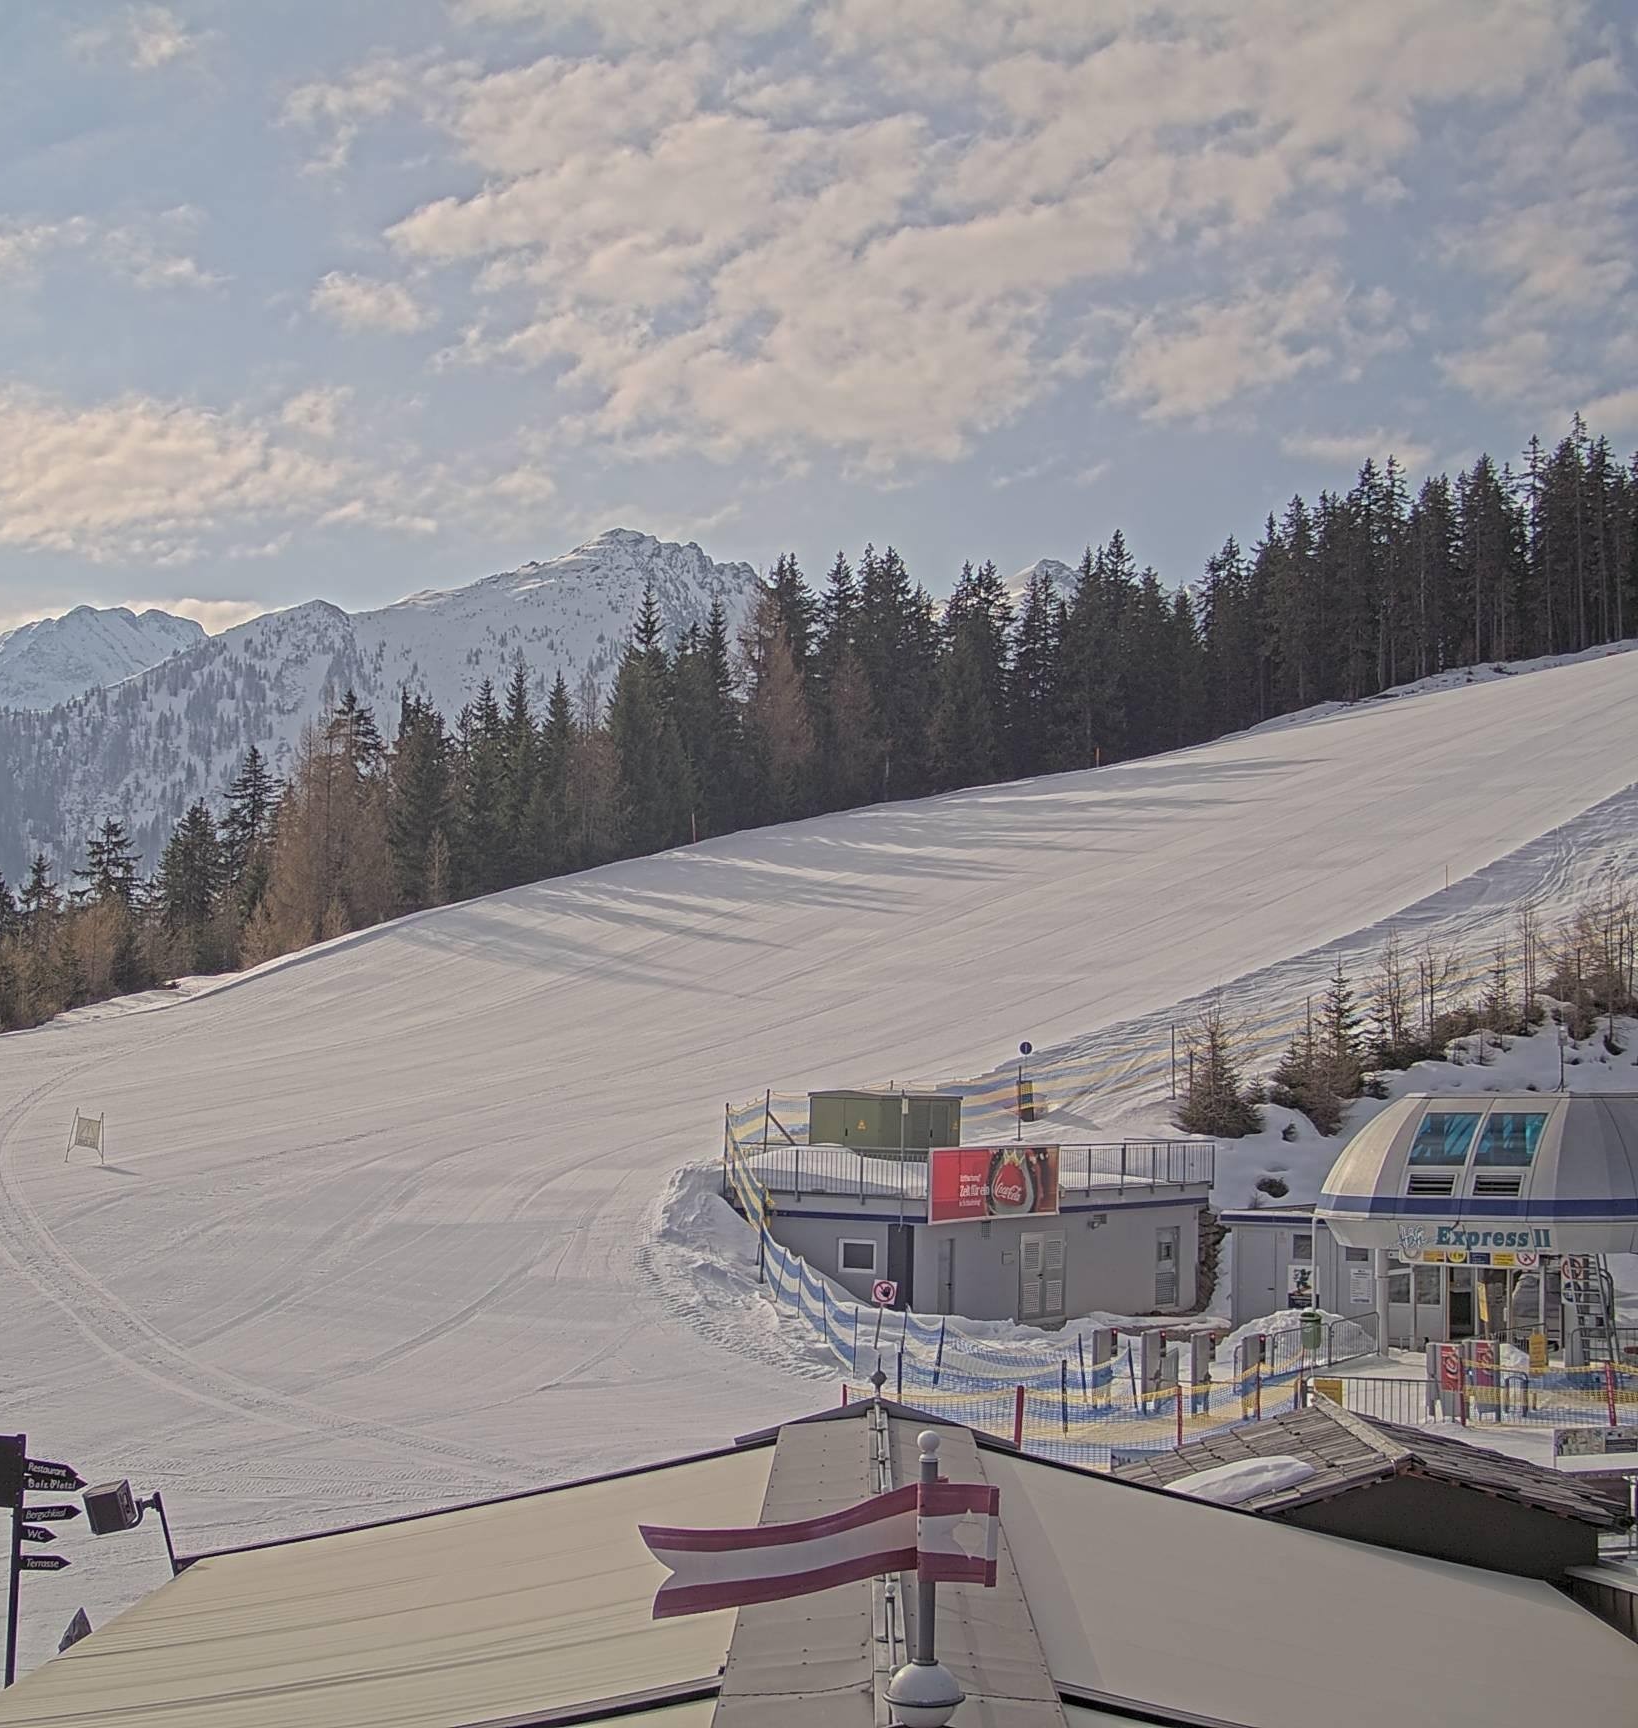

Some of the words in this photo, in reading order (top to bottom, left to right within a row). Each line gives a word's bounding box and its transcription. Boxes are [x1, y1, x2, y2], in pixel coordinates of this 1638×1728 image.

[1436, 1226, 1529, 1250] Express
[1533, 1228, 1551, 1248] II
[28, 1463, 67, 1477] Restaurant
[27, 1529, 45, 1540] WC
[26, 1558, 60, 1569] Terrasse
